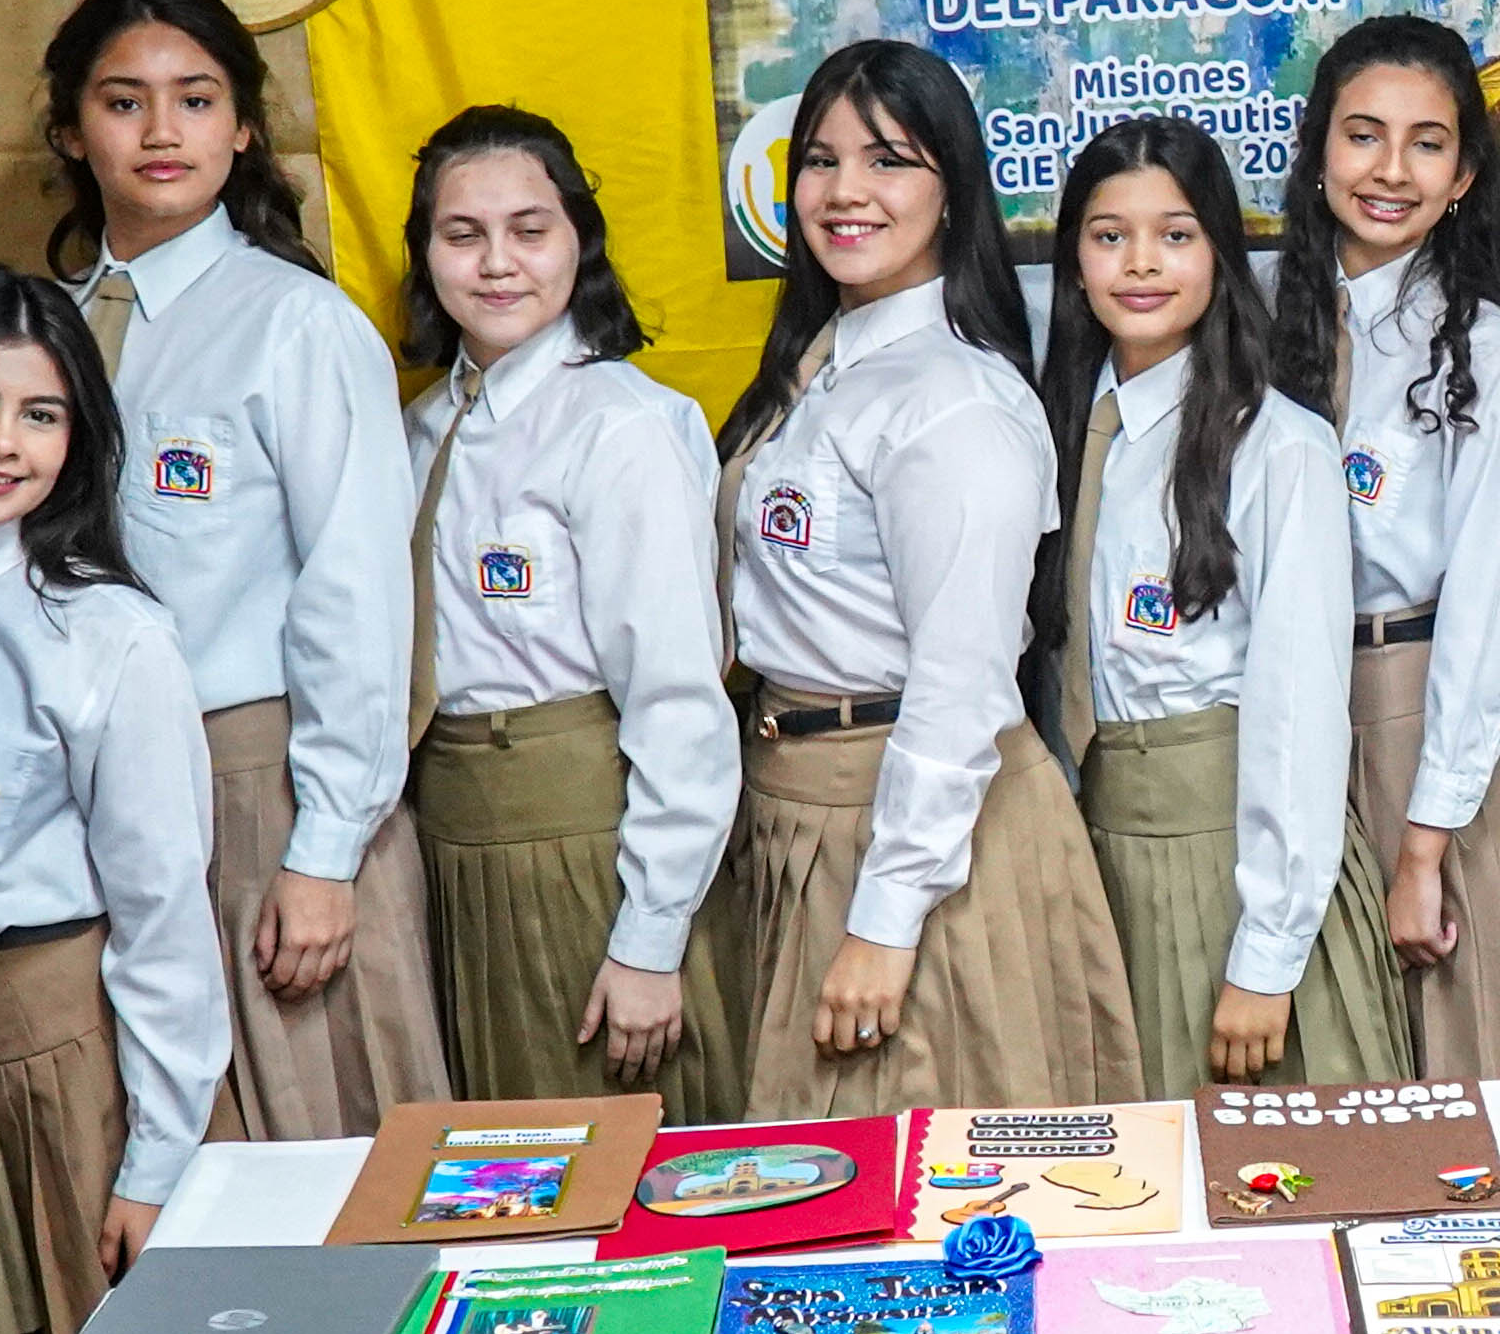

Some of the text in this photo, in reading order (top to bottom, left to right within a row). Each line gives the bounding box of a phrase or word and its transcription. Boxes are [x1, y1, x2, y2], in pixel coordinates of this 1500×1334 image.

[1075, 60, 1245, 99] Misiones
[992, 97, 1307, 146] San Ju Bautist
[996, 155, 1054, 188] CIE
[1220, 1082, 1464, 1108] SAN JUAN
[978, 1114, 1105, 1124] SAN JUAN
[1213, 1101, 1477, 1126] BAUTISTA
[976, 1127, 1112, 1137] BAUTISTA
[979, 1143, 1107, 1154] MISIONES
[729, 1275, 1008, 1307] San Juan
